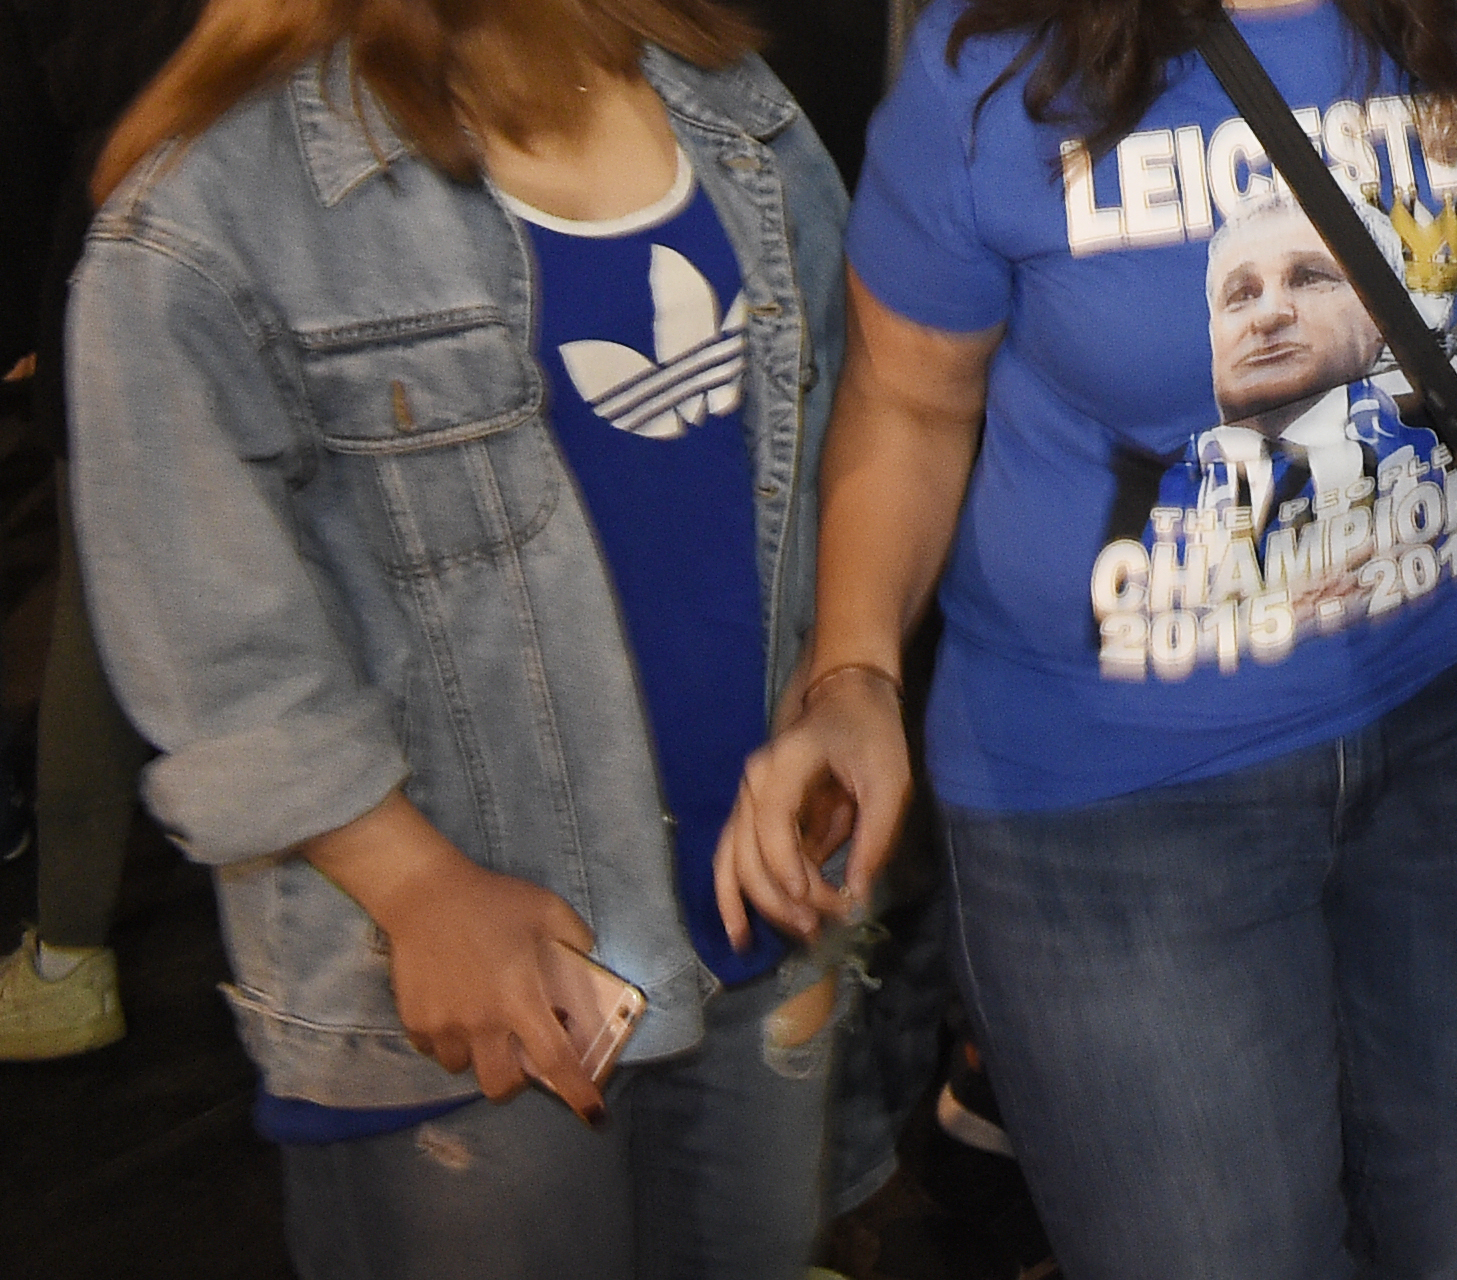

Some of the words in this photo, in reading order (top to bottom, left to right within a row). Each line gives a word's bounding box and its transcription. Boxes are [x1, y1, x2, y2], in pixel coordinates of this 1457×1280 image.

[1150, 506, 1254, 534] THE
[1279, 442, 1453, 522] PEOPLE
[1099, 591, 1295, 666] 2015
